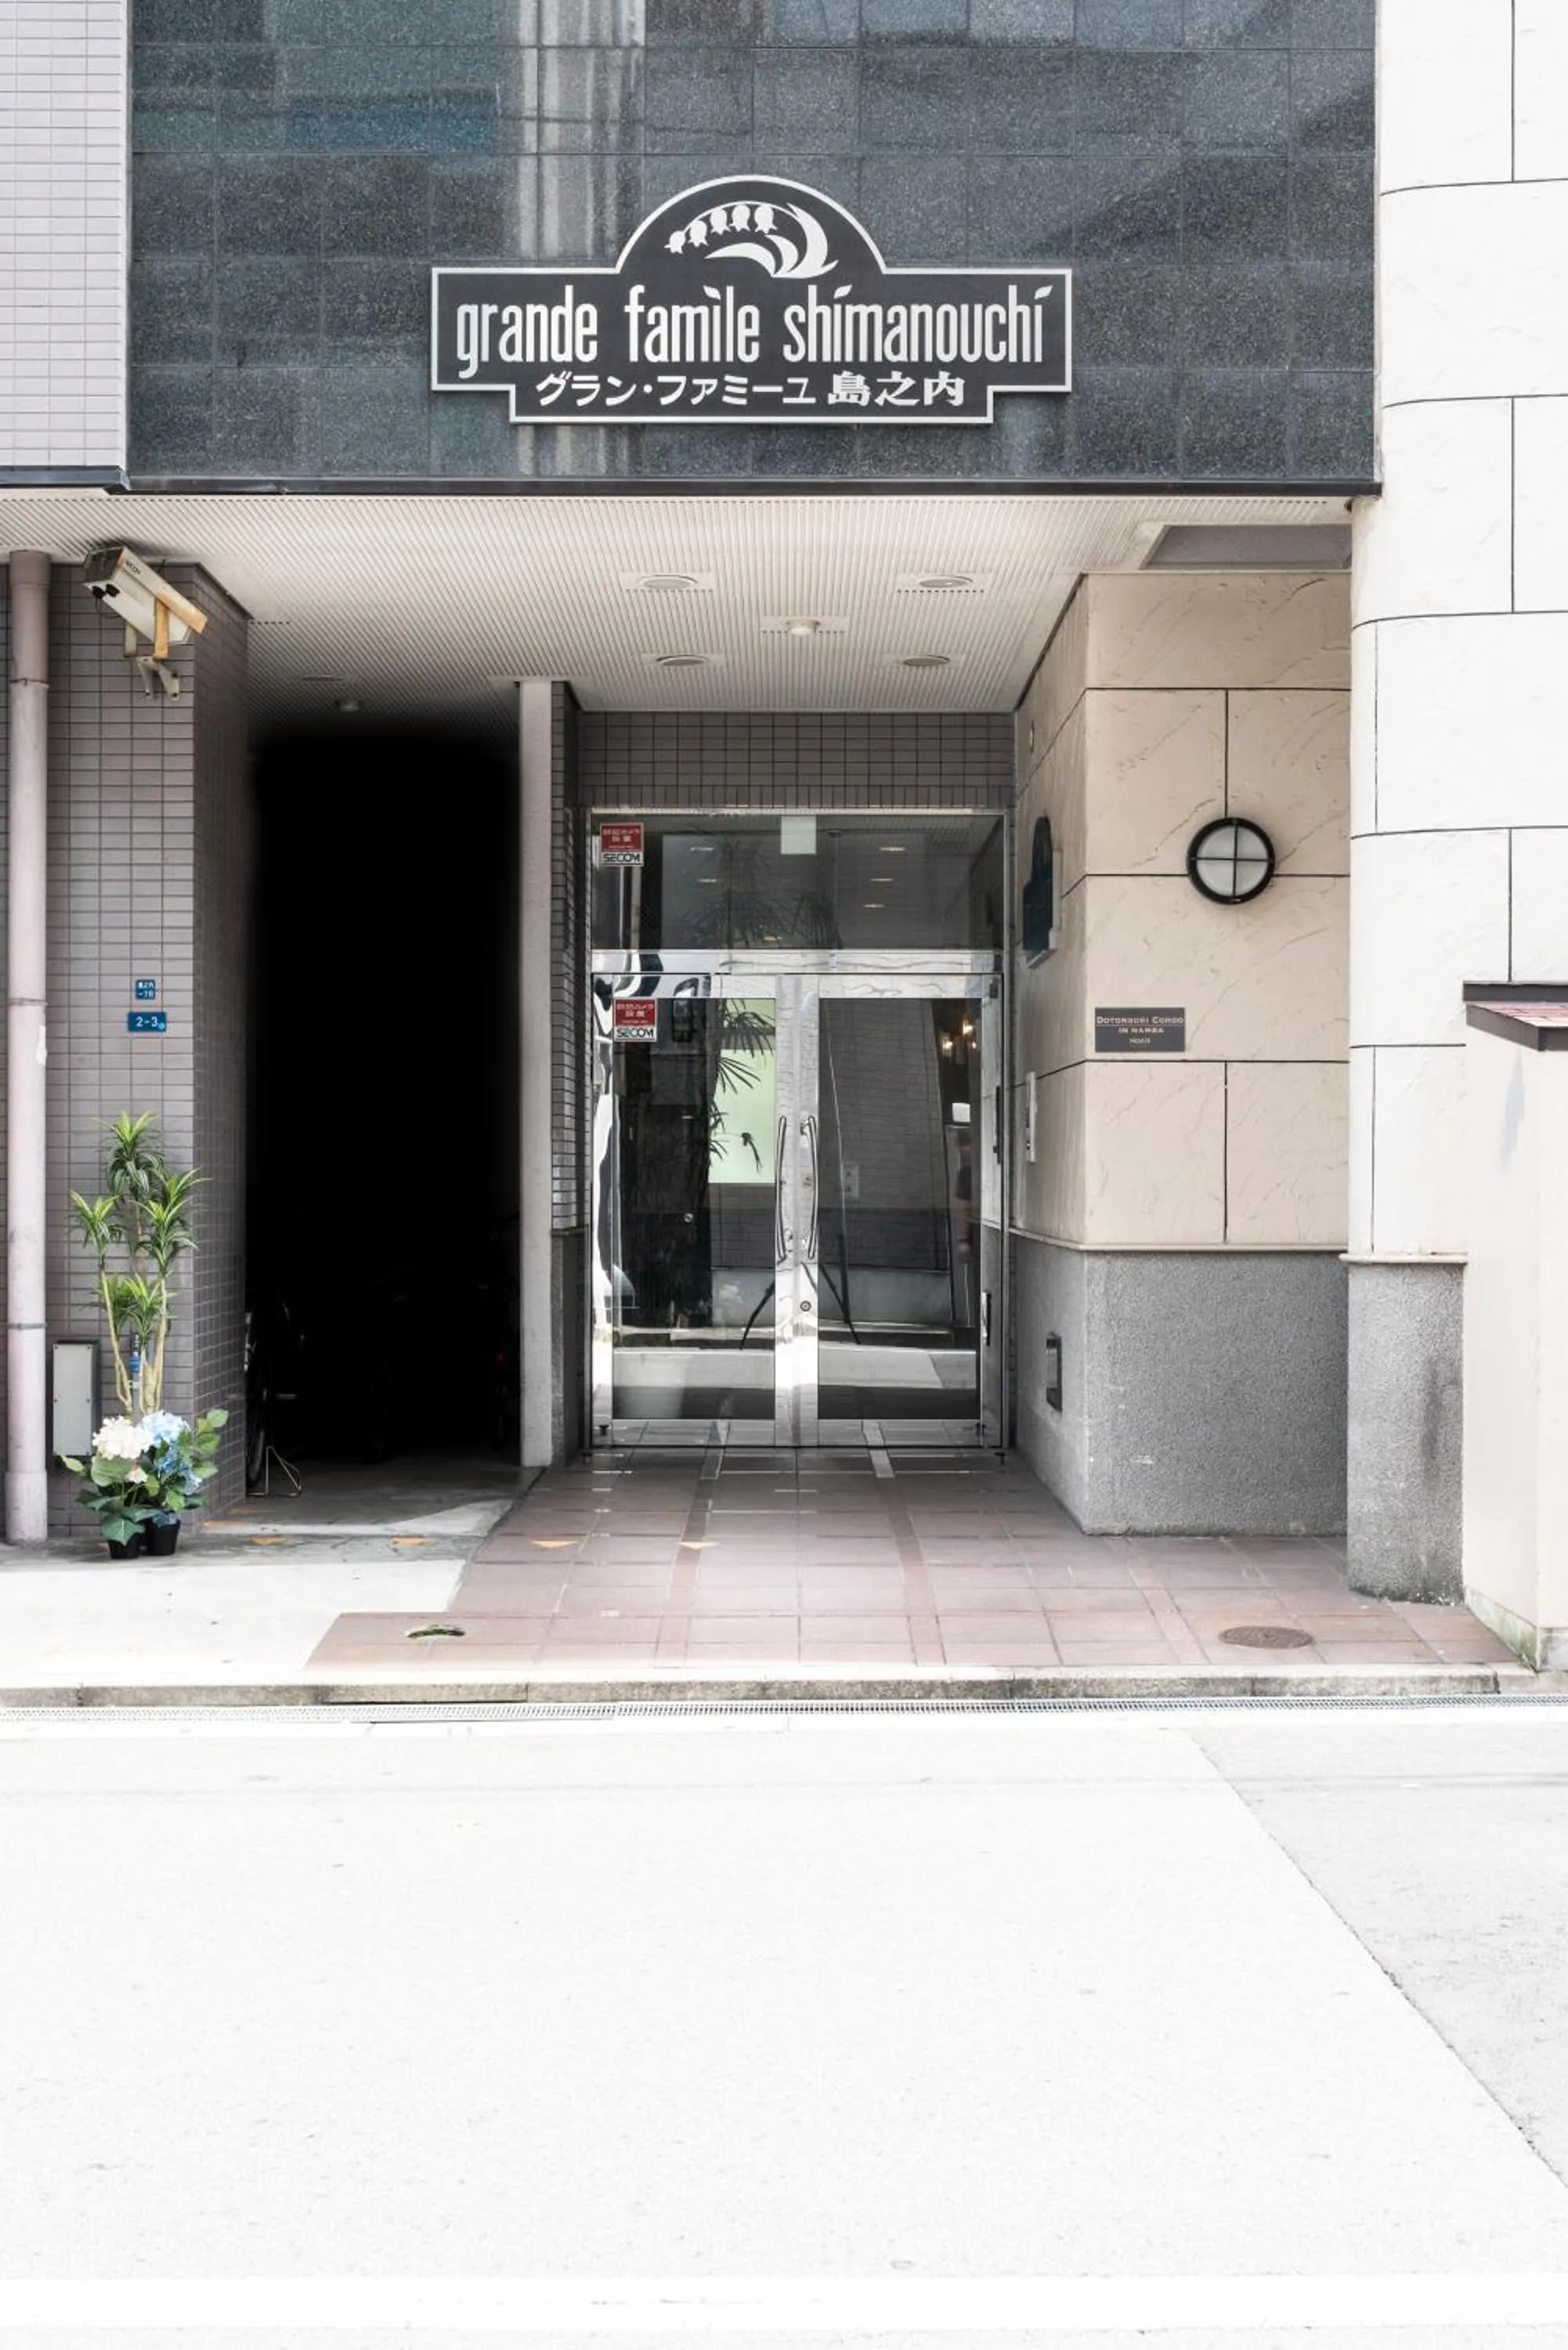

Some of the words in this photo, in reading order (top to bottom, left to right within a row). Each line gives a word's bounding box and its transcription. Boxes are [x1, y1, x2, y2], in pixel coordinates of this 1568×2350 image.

[456, 285, 598, 378] grande
[624, 284, 760, 363] famile
[783, 284, 1053, 363] shimanouchi
[536, 371, 816, 406] グラン・ファミーユ
[828, 371, 966, 407] 島之内
[602, 853, 640, 862] SECOM
[135, 1016, 158, 1027] 2-3
[616, 1028, 654, 1038] SECOM
